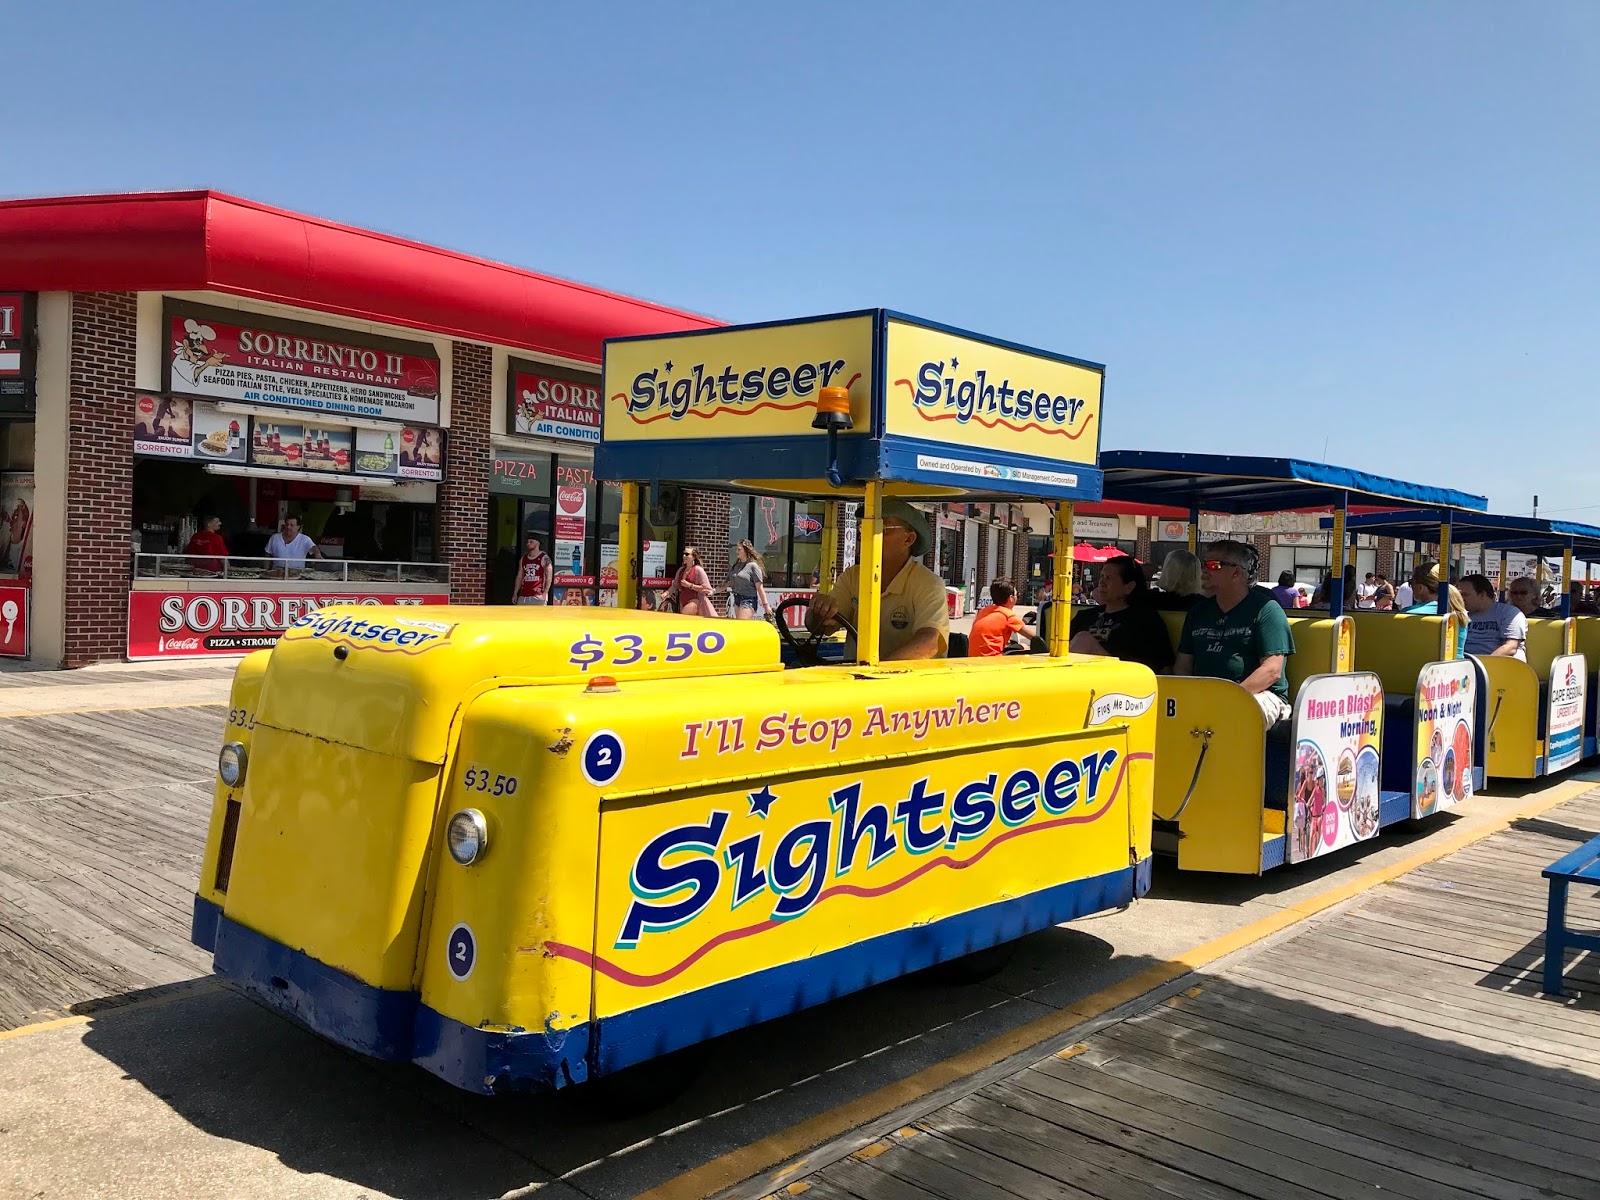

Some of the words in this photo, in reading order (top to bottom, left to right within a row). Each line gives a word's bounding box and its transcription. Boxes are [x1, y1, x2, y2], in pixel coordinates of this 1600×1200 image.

[238, 330, 378, 372] SORRENTO
[385, 355, 403, 376] II
[247, 355, 304, 371] ITALIAN
[313, 365, 400, 385] RESTAURANT
[203, 375, 235, 387] SEAFOOD
[236, 379, 262, 390] ITALIAN
[264, 382, 285, 394] STYLE,
[286, 385, 302, 395] VEAL
[303, 387, 342, 401] SPECIALTIES
[343, 392, 348, 401] &
[350, 393, 384, 407] HOMEMADE
[384, 398, 415, 410] MACARONI
[215, 368, 235, 379] PIZZA
[237, 371, 254, 381] PIES,
[256, 373, 277, 384] PASTA,
[279, 376, 310, 388] CHICKEN,
[311, 380, 350, 394] APPETIZERS,
[351, 386, 367, 396] HERO
[368, 388, 406, 401] SANDWICHES
[627, 357, 846, 420] Sightseer
[913, 356, 1085, 426] Sightseer
[244, 391, 260, 401] AIR
[262, 393, 324, 409] CONDITIONED
[326, 399, 356, 412] DINING
[357, 403, 382, 415] ROOM
[545, 405, 593, 424] ITALIAN
[537, 423, 553, 433] AIR
[136, 443, 182, 454] SORRENTO
[401, 468, 435, 477] SORRENTO
[494, 459, 537, 480] PIZZA
[556, 466, 598, 487] PASTA
[920, 458, 938, 469] Owned
[939, 461, 950, 470] and
[951, 462, 974, 474] Operated
[974, 465, 982, 475] by
[1022, 471, 1050, 483] Management
[1050, 475, 1076, 486] Corporation
[797, 517, 819, 531] SEAFOOD
[1089, 520, 1113, 528] Treasures
[526, 568, 536, 577] 33
[292, 612, 439, 648] Sightseer
[209, 639, 236, 647] PIZZA
[568, 631, 726, 672] $3.50
[1437, 681, 1450, 699] the
[1113, 700, 1122, 710] Me
[1125, 700, 1144, 711] Down
[1166, 698, 1176, 717] B
[1307, 697, 1336, 720] Have
[1338, 700, 1344, 716] a
[1418, 708, 1437, 722] Noon
[1440, 703, 1445, 719] &
[680, 717, 745, 760] I'll
[755, 711, 852, 755] Stop
[861, 697, 1022, 740] Anywhere
[597, 747, 612, 766] 2
[463, 765, 518, 798] $3.50
[612, 748, 1118, 950] Sightseer
[455, 942, 467, 961] 2
